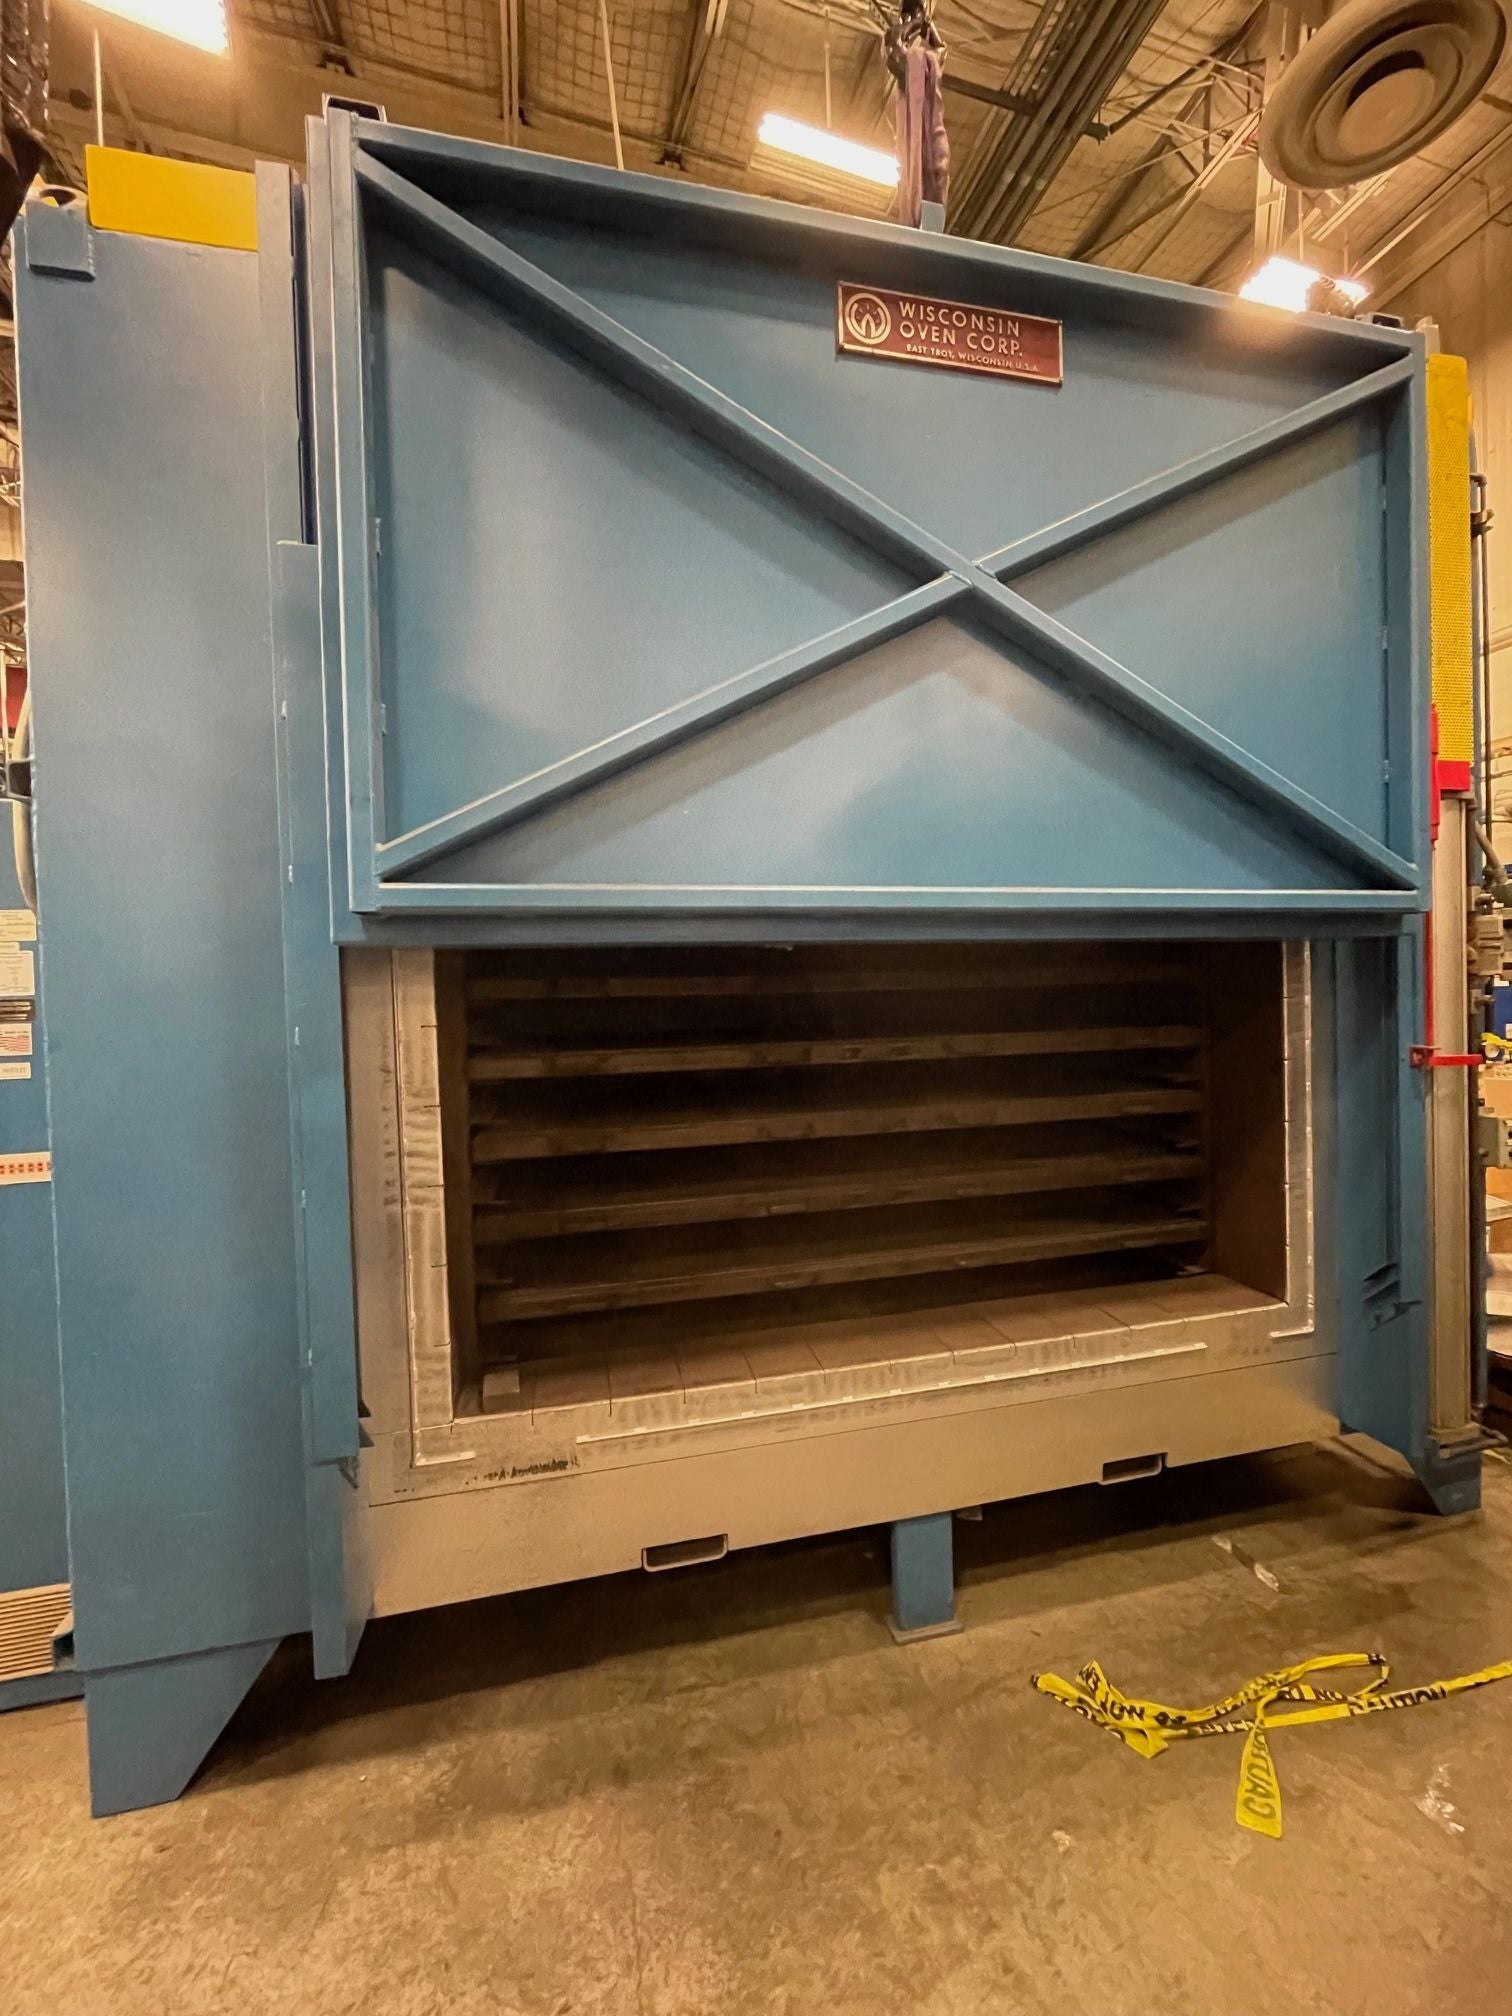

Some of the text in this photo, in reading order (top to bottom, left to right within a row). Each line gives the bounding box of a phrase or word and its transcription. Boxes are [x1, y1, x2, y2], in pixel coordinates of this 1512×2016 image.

[899, 300, 1020, 338] WISCONSIN
[899, 321, 1023, 357] OVEN CORP.
[906, 343, 928, 355] EAST
[930, 347, 956, 360] TROY,
[958, 351, 1013, 368] WISCONSIN
